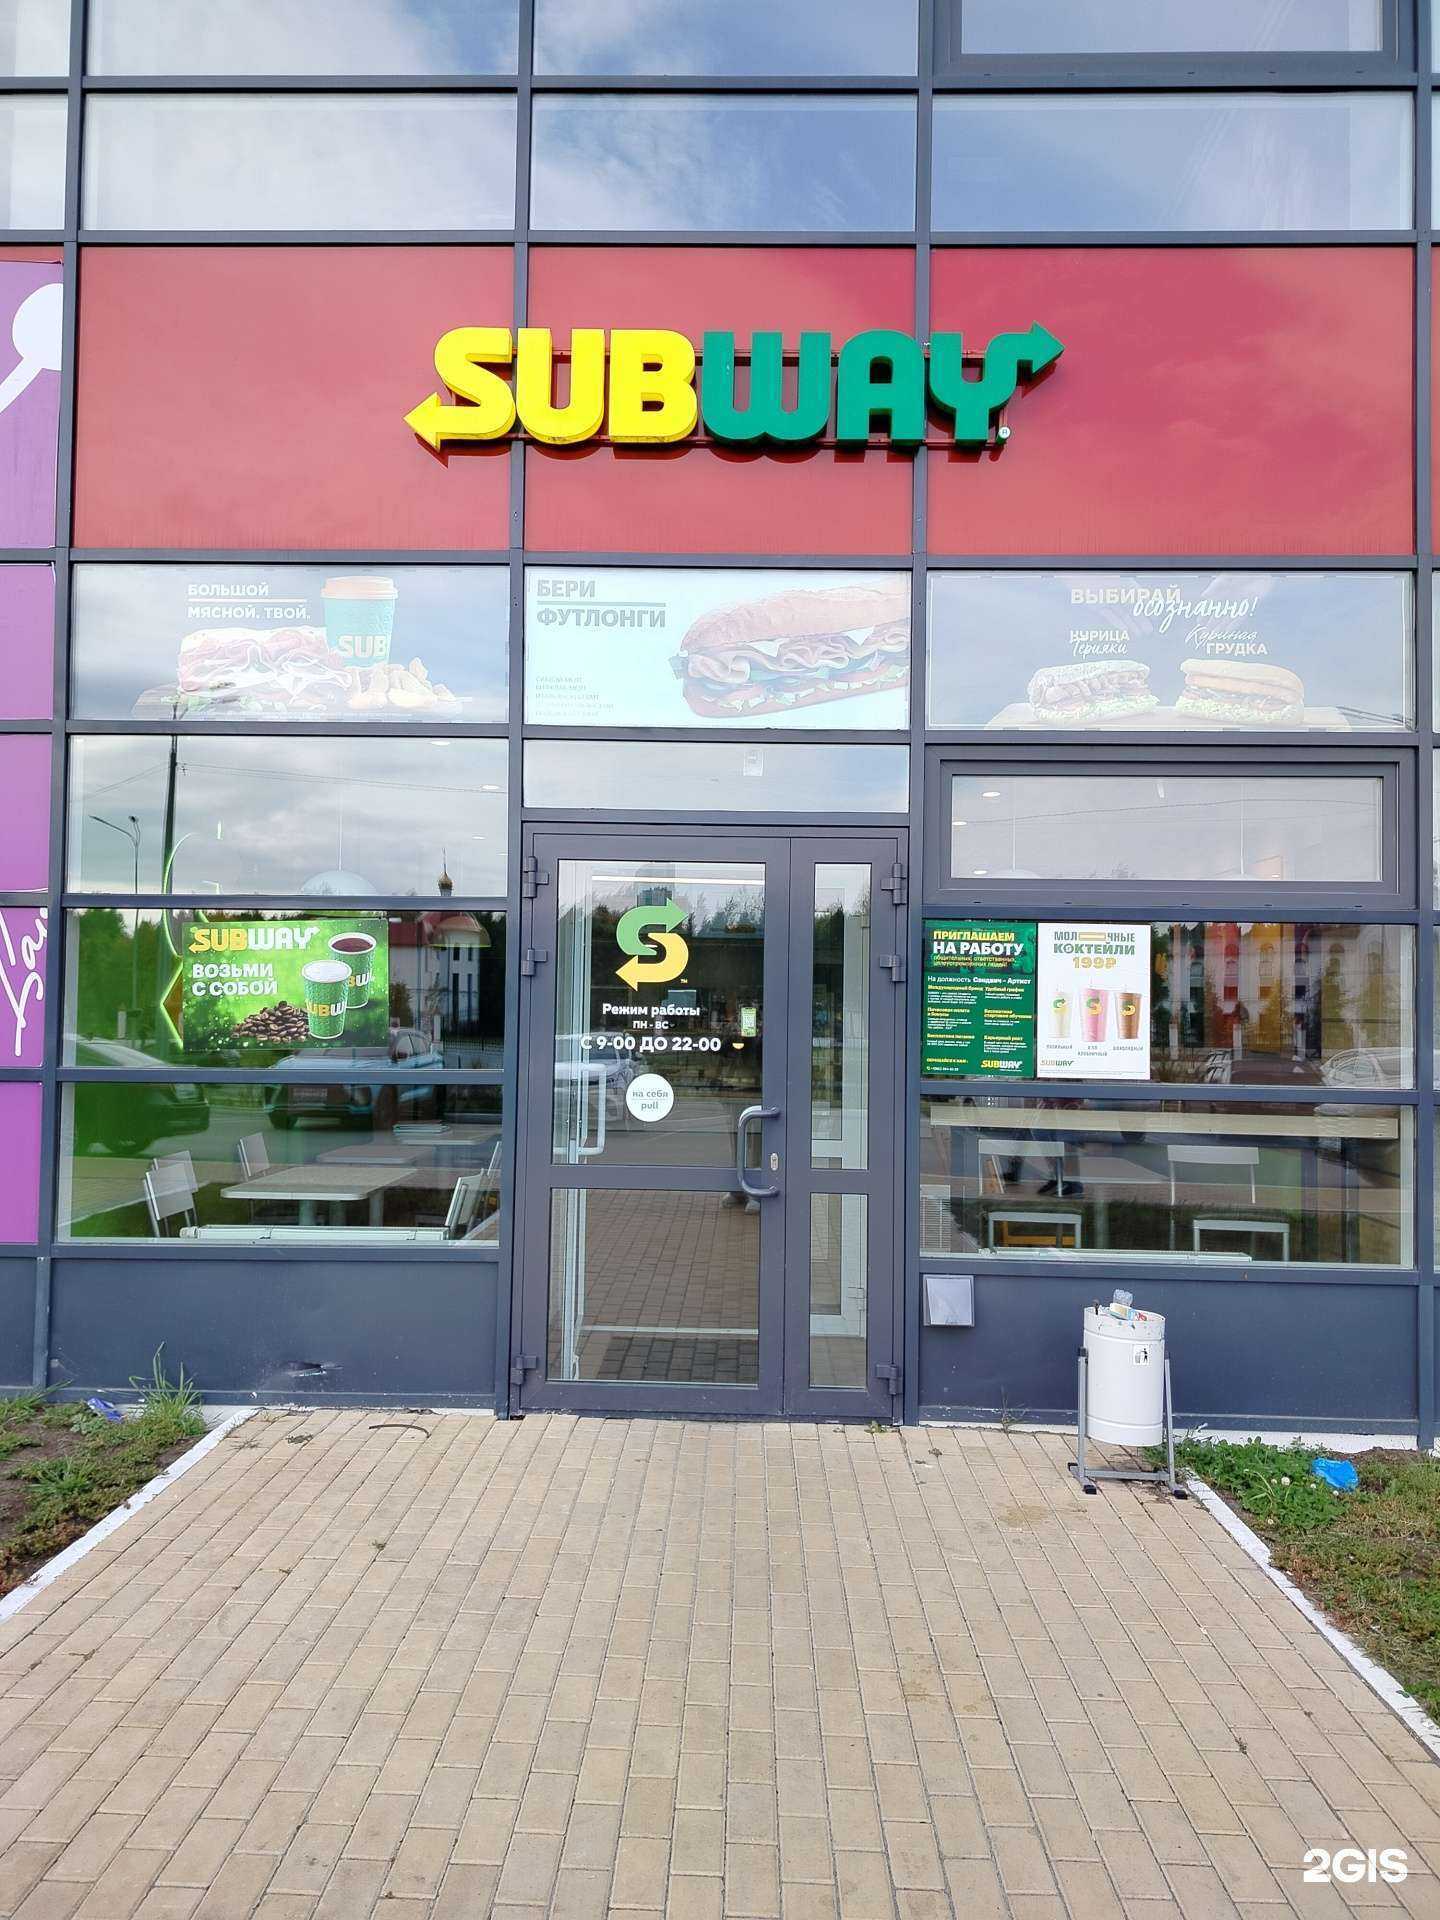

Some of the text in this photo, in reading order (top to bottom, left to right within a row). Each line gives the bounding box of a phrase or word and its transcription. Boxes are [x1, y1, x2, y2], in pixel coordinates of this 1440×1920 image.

[403, 322, 1064, 448] SUBWAY
[187, 582, 269, 597] БОЛЬШОЙ
[536, 579, 596, 598] БЕРИ
[1070, 584, 1181, 605] ВЫБИРАЙ
[536, 607, 667, 628] ФУТЛОНГИ
[1133, 596, 1259, 633] осознанно!
[337, 635, 388, 658] SUB
[1206, 642, 1268, 656] ГРУДКА
[188, 927, 321, 954] SUBWAY
[933, 930, 1015, 942] ПРИГЛАШАЕМ
[933, 941, 1025, 956] НА РАБОТУ
[1053, 942, 1136, 955] КОКТЕЙЛИ
[191, 963, 274, 978] ВОЗЬМИ
[191, 978, 278, 996] С СОБОЙ
[1007, 977, 1032, 985] Артист
[602, 1003, 701, 1017] Режим работы
[580, 1037, 722, 1053] С 9-00 ДО 22-00
[980, 1060, 1023, 1069] SUBWAY
[632, 1089, 669, 1098] на себя
[641, 1101, 659, 1111] pull
